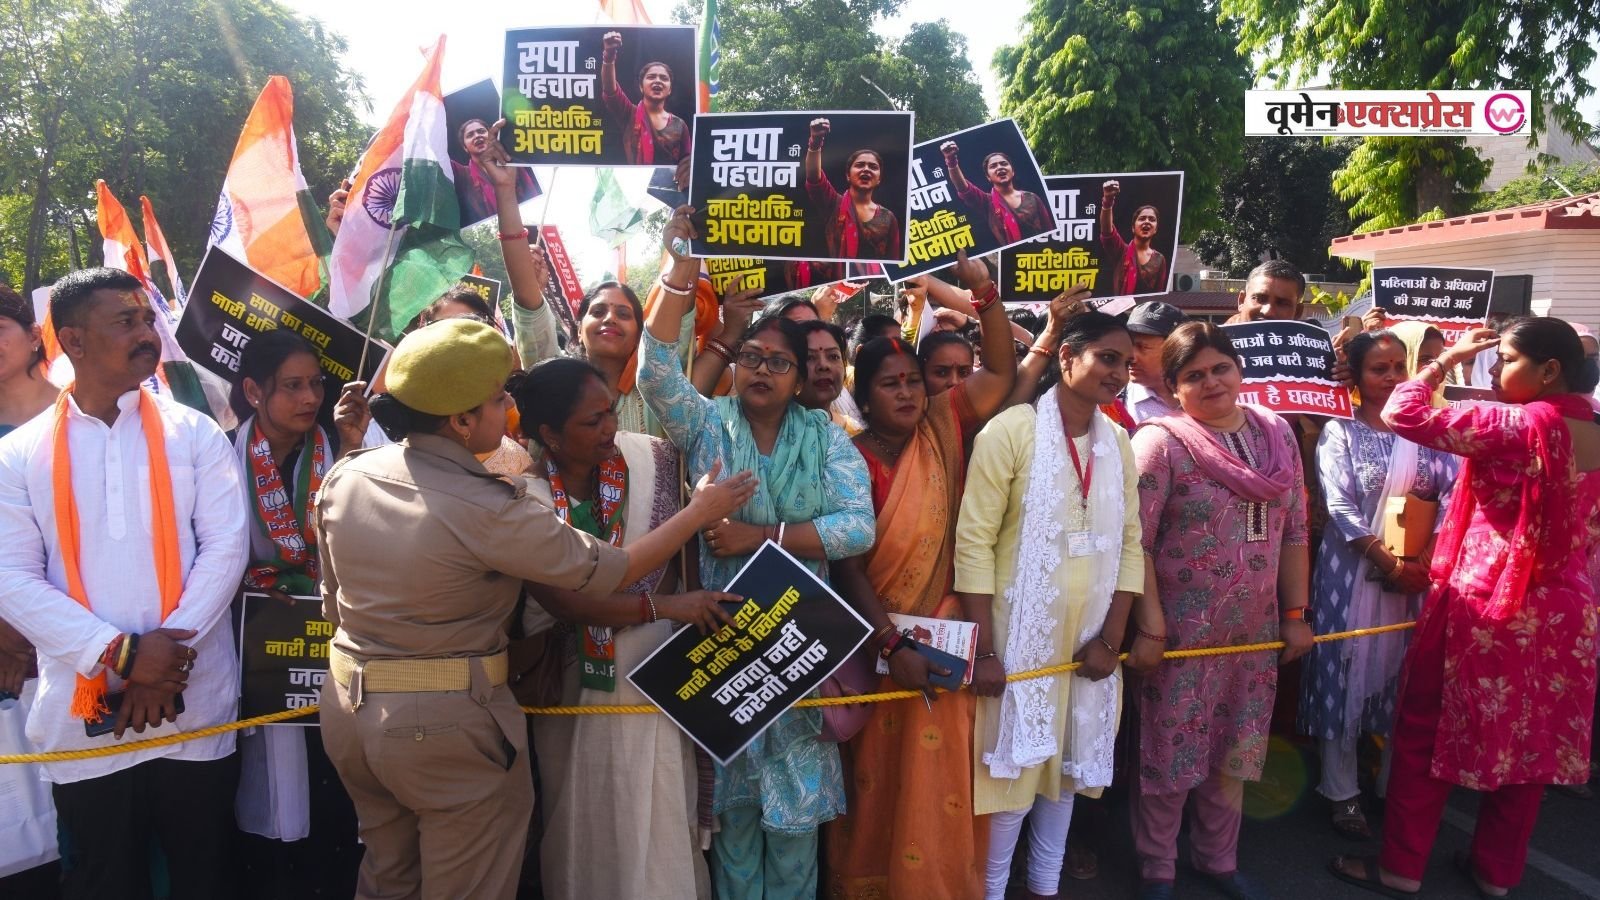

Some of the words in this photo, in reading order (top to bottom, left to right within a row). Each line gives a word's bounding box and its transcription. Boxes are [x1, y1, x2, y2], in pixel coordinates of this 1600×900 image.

[517, 40, 580, 73] सपा
[584, 56, 596, 70] की
[517, 73, 597, 99] पहचान
[513, 104, 592, 128] नारीशक्ति
[513, 128, 604, 155] अपमान
[711, 127, 784, 161] सपा
[788, 144, 802, 158] की
[711, 161, 801, 188] पहचान
[706, 193, 794, 219] नारीशक्ति
[1084, 203, 1097, 215] की
[705, 219, 805, 247] अपमान
[1015, 247, 1091, 270] नारीशक्ति
[1379, 276, 1428, 290] महिलाओं
[1429, 276, 1442, 290] के
[1443, 278, 1488, 293] अधिकारों
[211, 290, 247, 320] नारी
[1393, 293, 1409, 306] की
[1411, 296, 1429, 307] जब
[1430, 295, 1451, 308] बारी
[1453, 296, 1474, 311] आई
[249, 291, 282, 320] सपा
[280, 310, 302, 332] का
[301, 322, 332, 349] हाथ
[1267, 332, 1283, 346] के
[1287, 333, 1331, 353] अधिकारों
[1249, 354, 1274, 367] जब
[1276, 351, 1303, 366] बारी
[1305, 356, 1327, 371] आई
[1264, 384, 1281, 406] है
[305, 620, 333, 637] सप
[264, 637, 306, 657] नारी
[675, 668, 712, 701] नारी
[706, 646, 740, 676] शक्ति
[733, 635, 755, 652] के
[747, 585, 801, 641] खिलाफ
[685, 637, 719, 665] सपा
[711, 657, 772, 706] जनता
[762, 618, 808, 664] नहीं
[729, 673, 789, 726] करेगी
[780, 638, 828, 682] माफ
